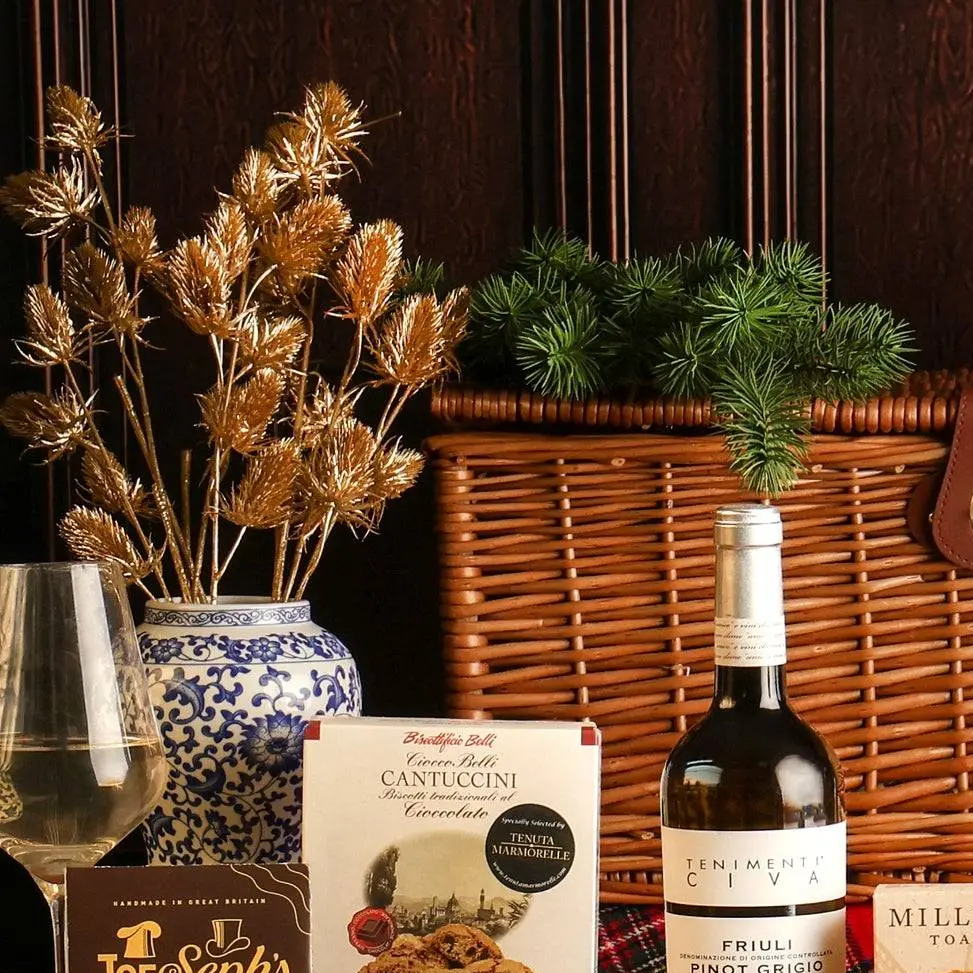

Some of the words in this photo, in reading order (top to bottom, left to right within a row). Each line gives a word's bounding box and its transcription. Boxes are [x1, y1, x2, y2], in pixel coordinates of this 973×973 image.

[381, 770, 517, 789] CANTUCCINI
[509, 832, 554, 846] TENUTA
[492, 845, 570, 861] MARMORELLE
[722, 939, 792, 951] FRIULI
